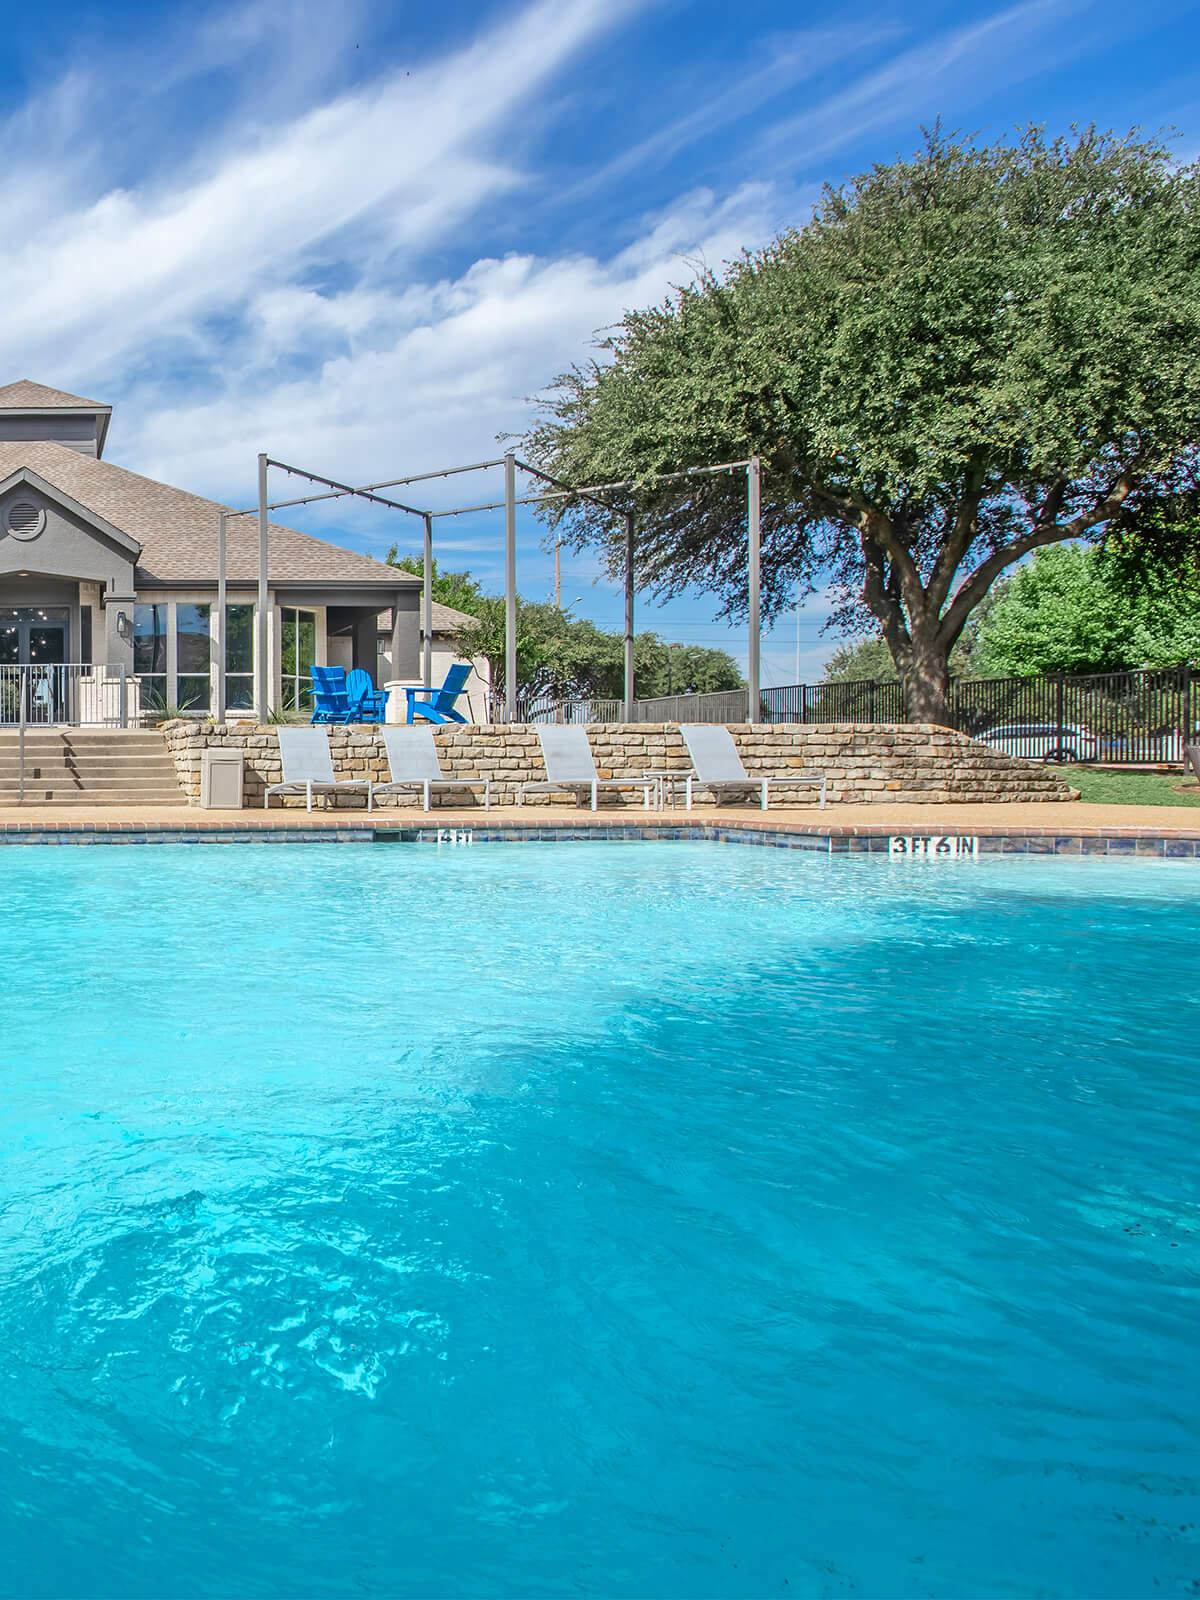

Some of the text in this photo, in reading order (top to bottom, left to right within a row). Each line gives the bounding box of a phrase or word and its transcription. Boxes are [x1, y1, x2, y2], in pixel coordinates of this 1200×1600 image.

[440, 829, 472, 843] 4 FT
[893, 837, 974, 853] 3 FT 6 IN
